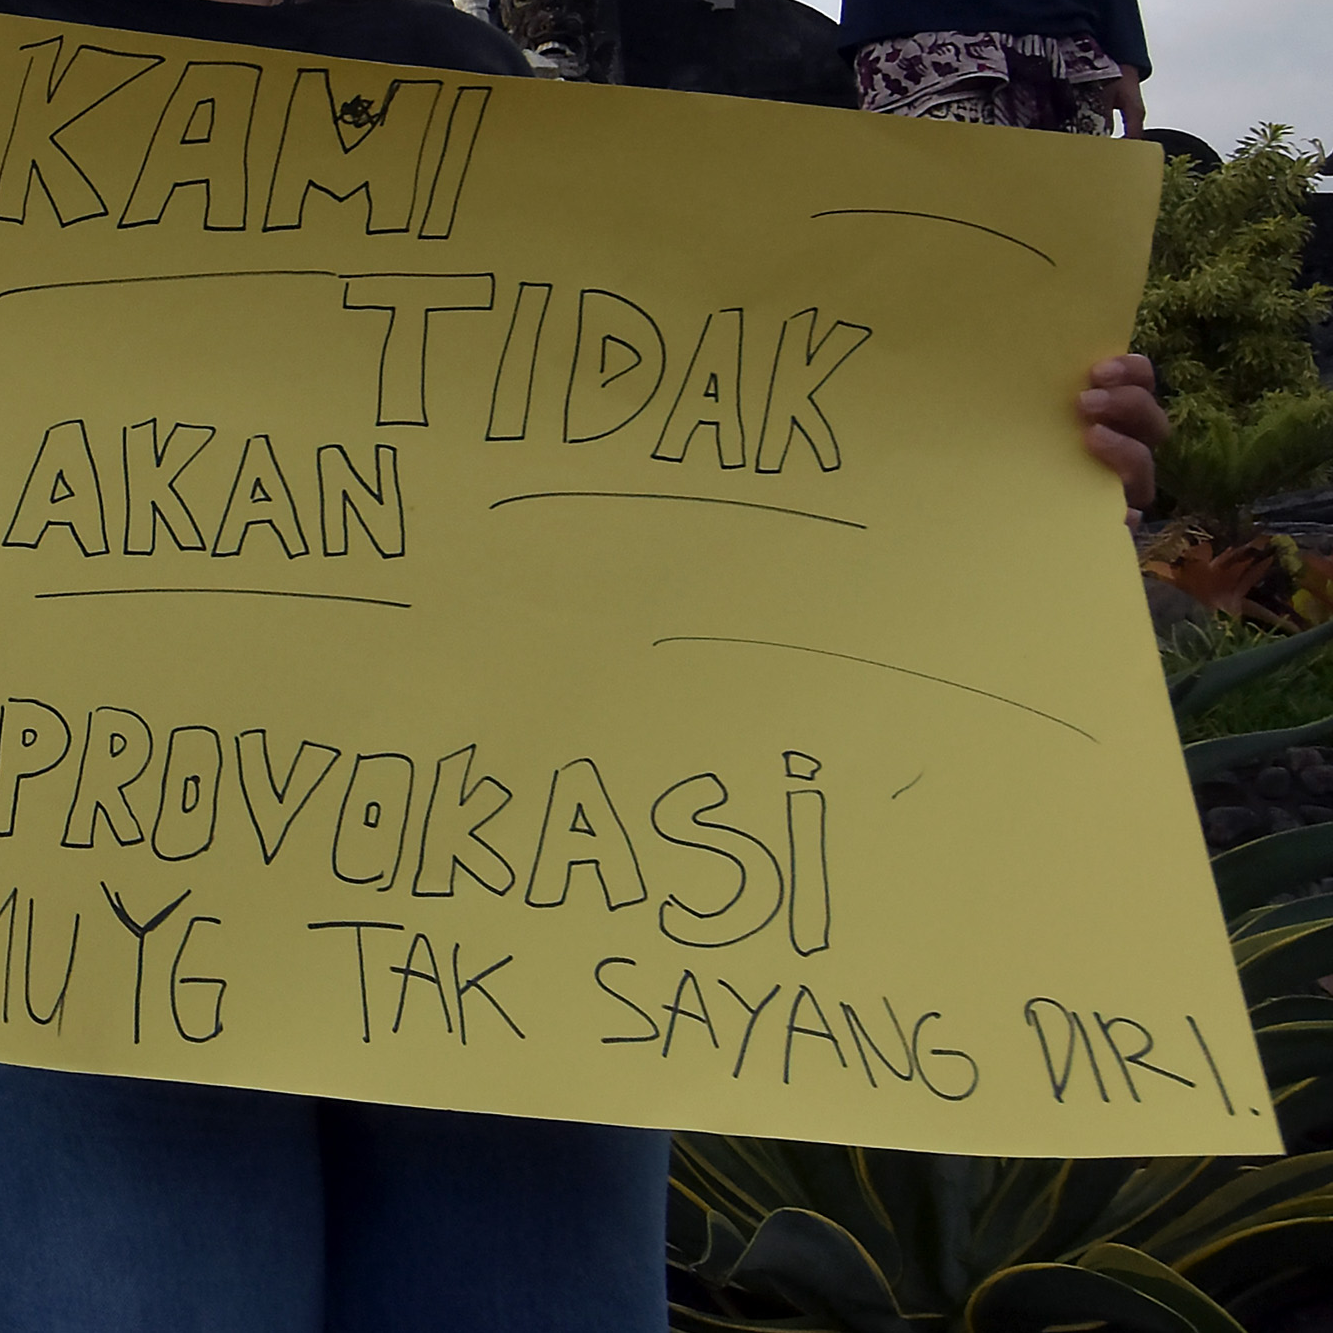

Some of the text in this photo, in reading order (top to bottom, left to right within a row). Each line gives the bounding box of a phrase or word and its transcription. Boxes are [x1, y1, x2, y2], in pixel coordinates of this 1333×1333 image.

[343, 272, 873, 474] TIDAK
[1, 417, 406, 559] AKAN
[307, 921, 525, 1046] TAK
[595, 957, 978, 1101] SAYANG
